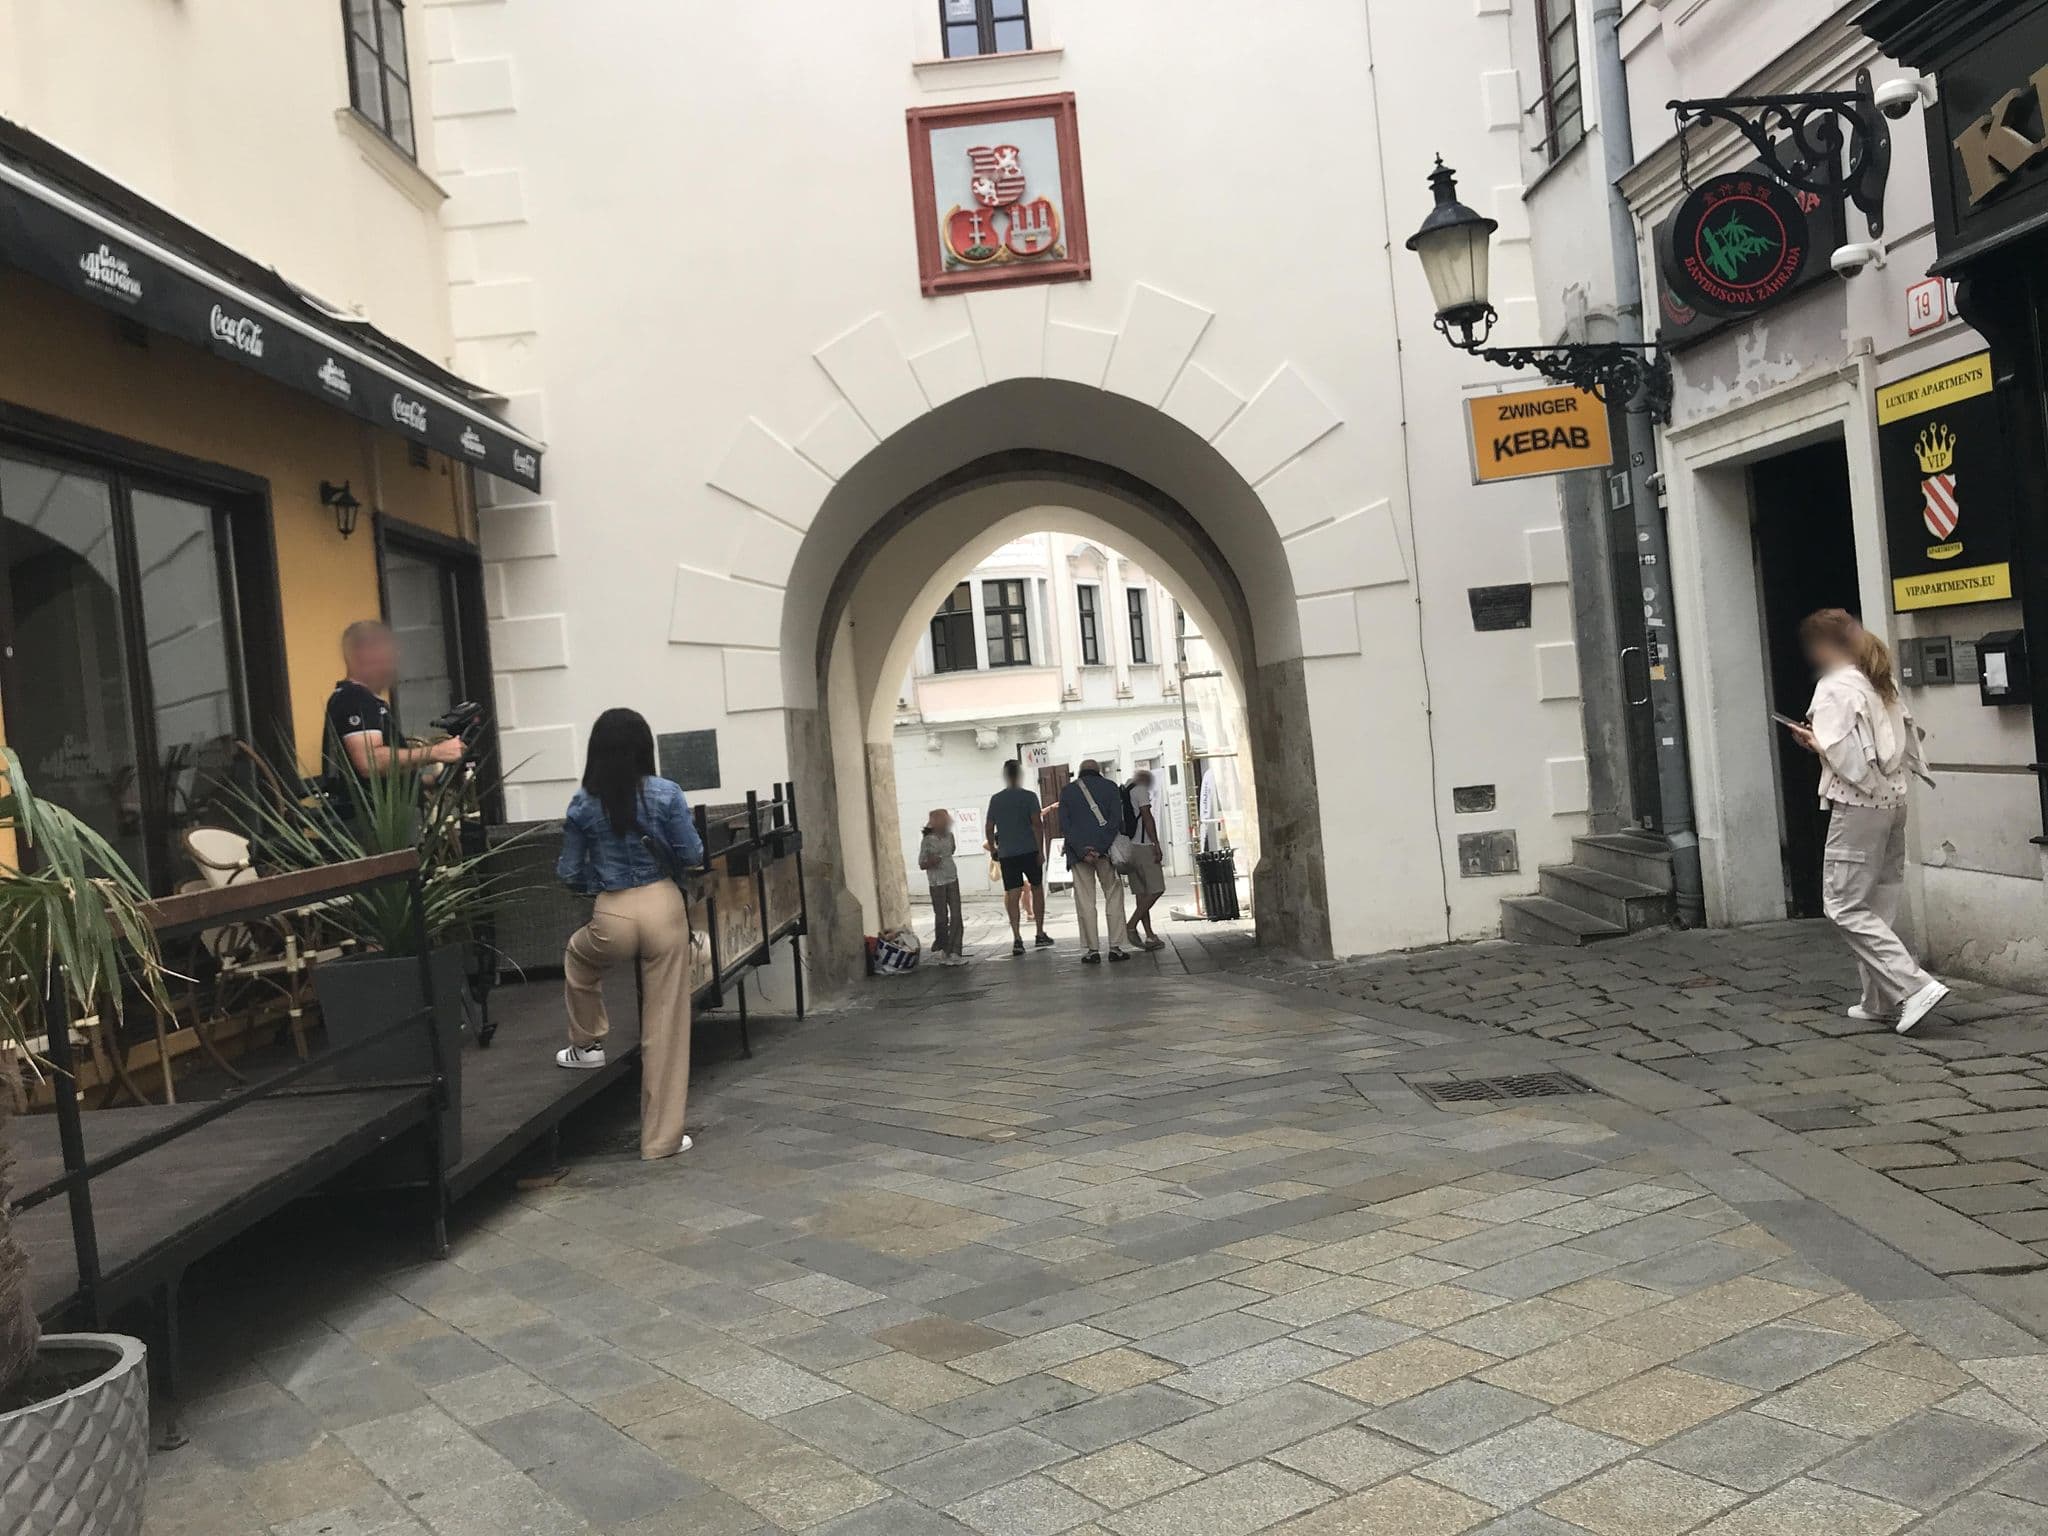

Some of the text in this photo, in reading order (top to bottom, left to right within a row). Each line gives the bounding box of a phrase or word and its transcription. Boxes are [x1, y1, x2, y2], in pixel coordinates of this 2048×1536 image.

[99, 244, 130, 275] Casa
[1684, 247, 1801, 304] BAMBUSOVÁ ZÁHRADA
[1916, 291, 1930, 320] 19
[1885, 368, 1983, 409] LUXURY APARTMENTS
[1498, 397, 1578, 421] ZWINGER
[1493, 426, 1590, 462] KEBAB
[1927, 452, 1947, 469] VIP
[1905, 575, 1996, 597] VIPAPARTMENTS.EU
[1032, 747, 1047, 757] WC
